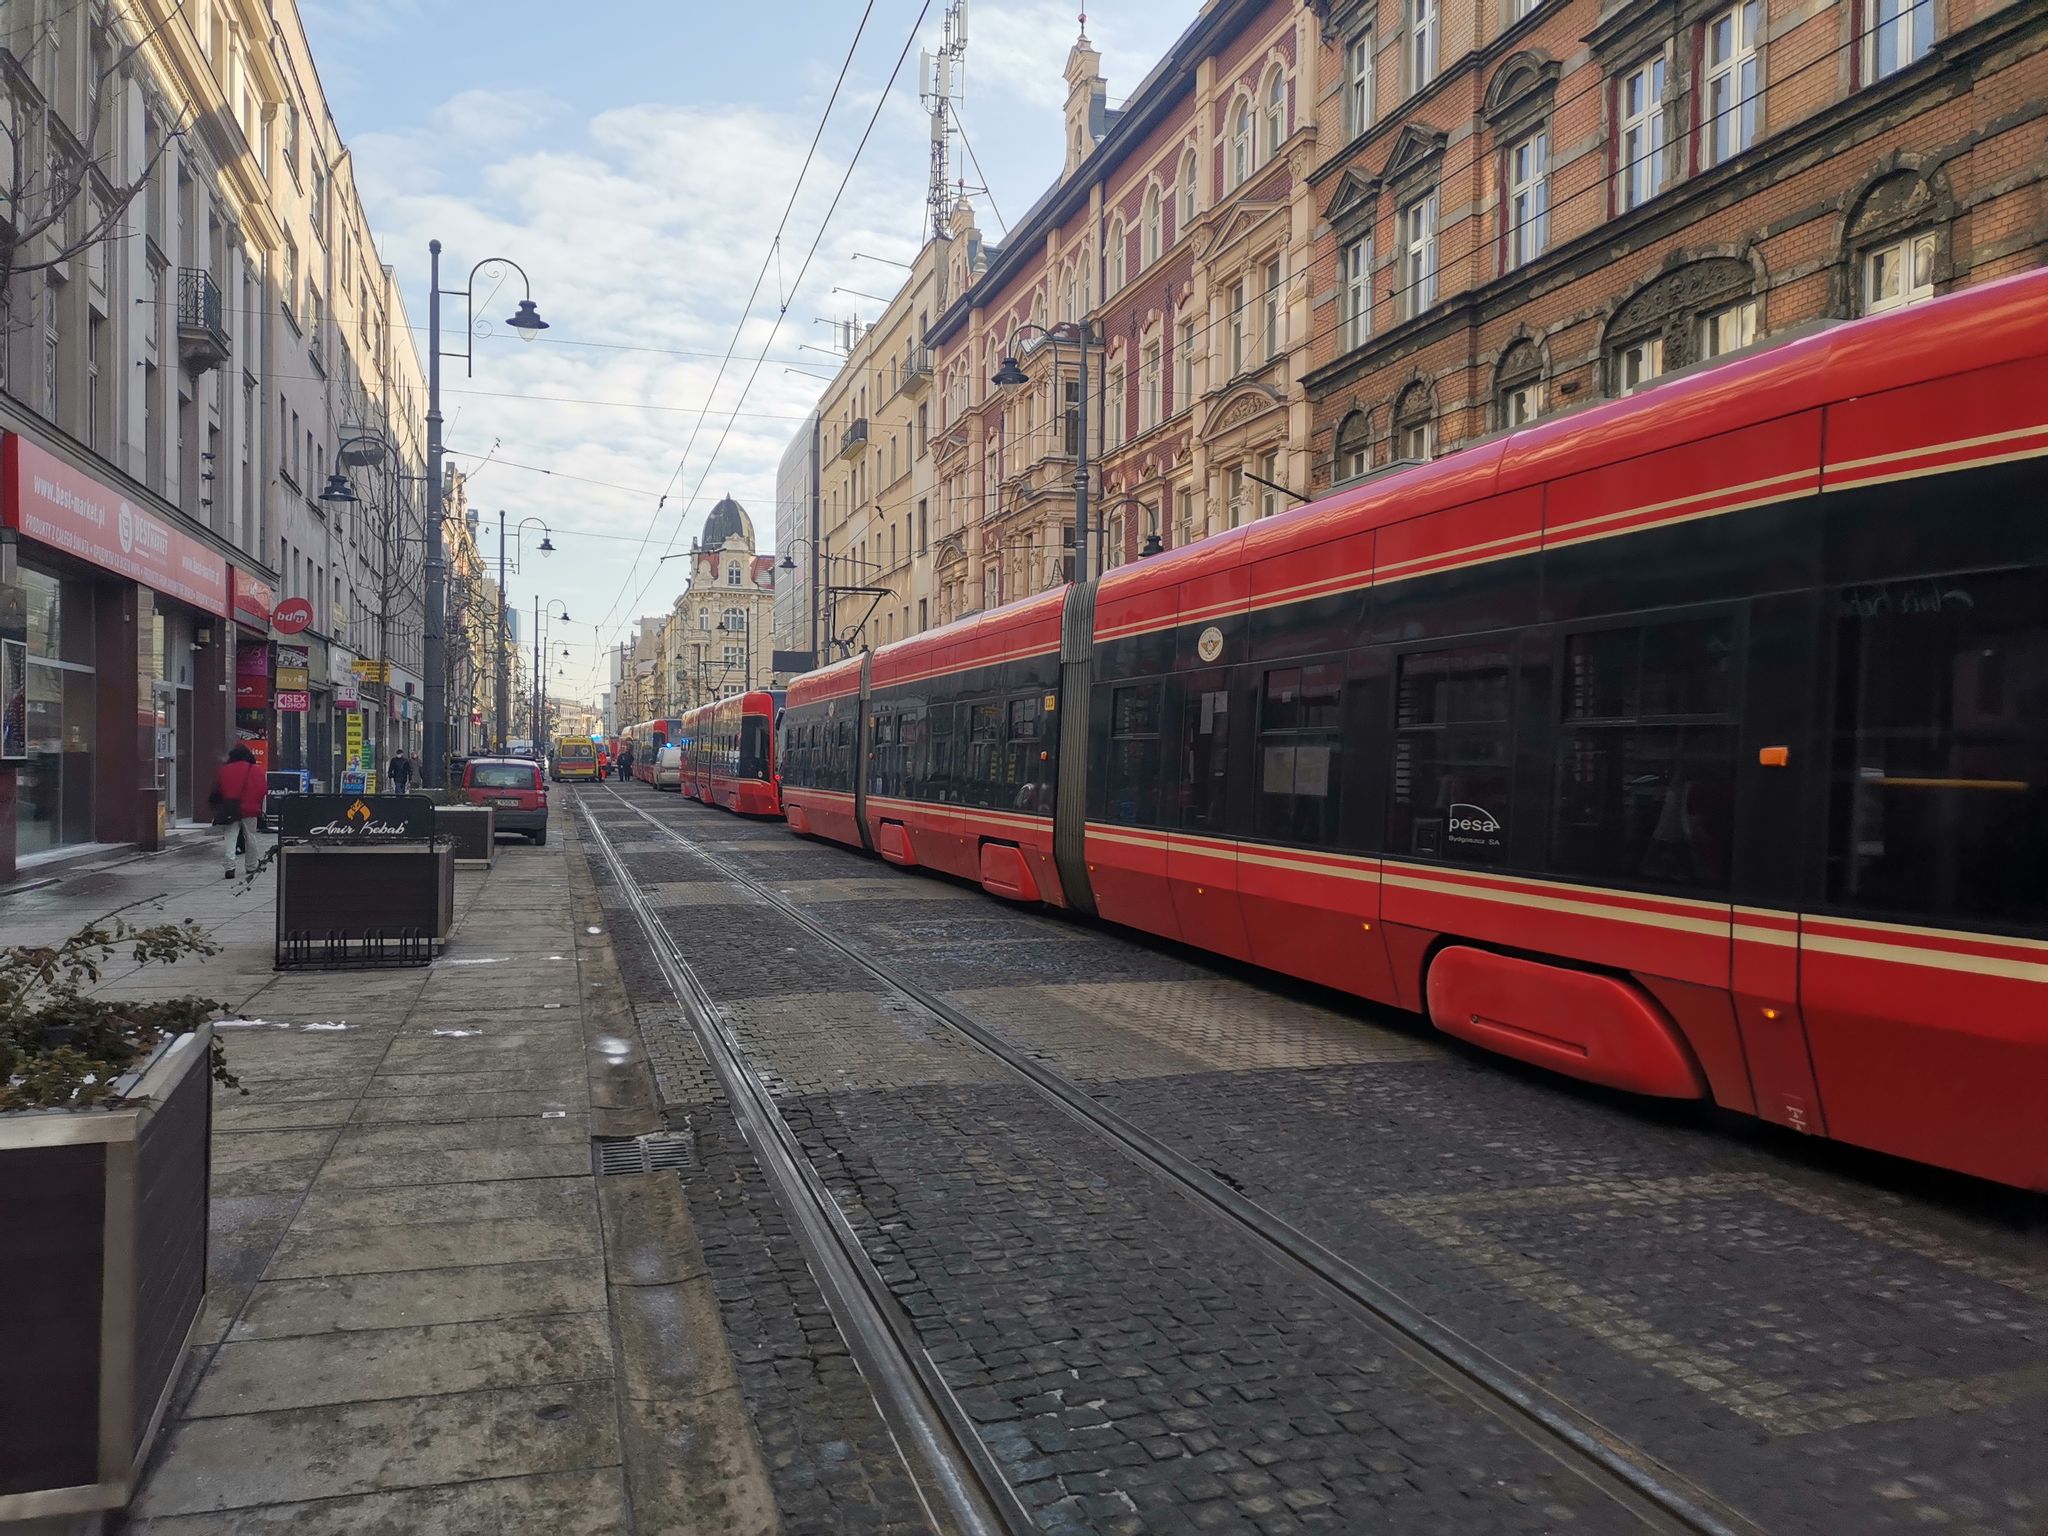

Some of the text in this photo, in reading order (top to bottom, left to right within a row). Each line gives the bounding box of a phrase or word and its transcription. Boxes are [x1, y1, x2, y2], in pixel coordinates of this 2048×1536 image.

[34, 475, 105, 529] www.best-market.pl
[287, 694, 307, 703] SEX
[310, 820, 406, 835] Amir Kebab
[1448, 818, 1495, 832] pesa
[1488, 838, 1500, 846] SA
